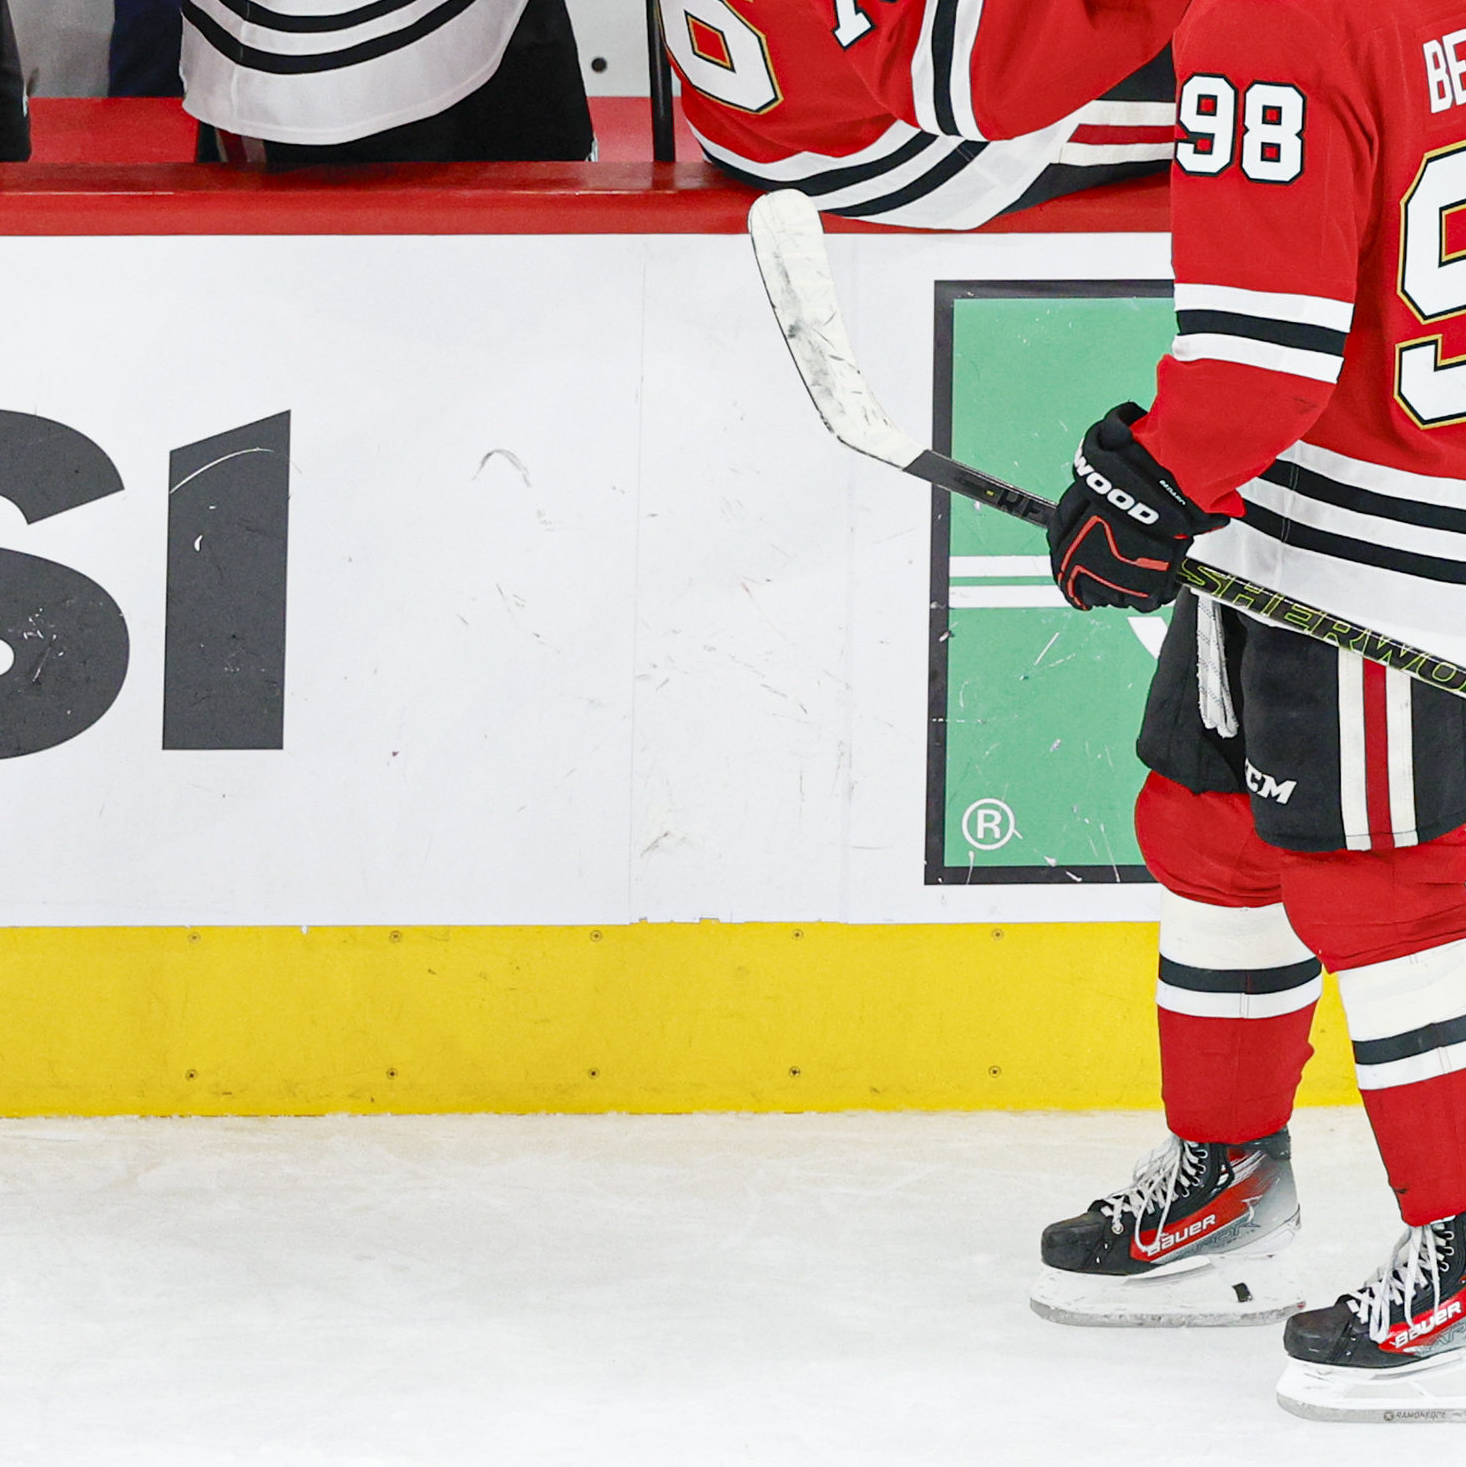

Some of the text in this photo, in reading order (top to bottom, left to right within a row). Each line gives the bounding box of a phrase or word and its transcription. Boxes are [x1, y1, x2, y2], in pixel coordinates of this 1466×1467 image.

[1175, 72, 1308, 185] 98
[1158, 479, 1186, 506] BEDARD
[1145, 1213, 1217, 1258] BAUER
[1389, 1300, 1463, 1349] BAUER
